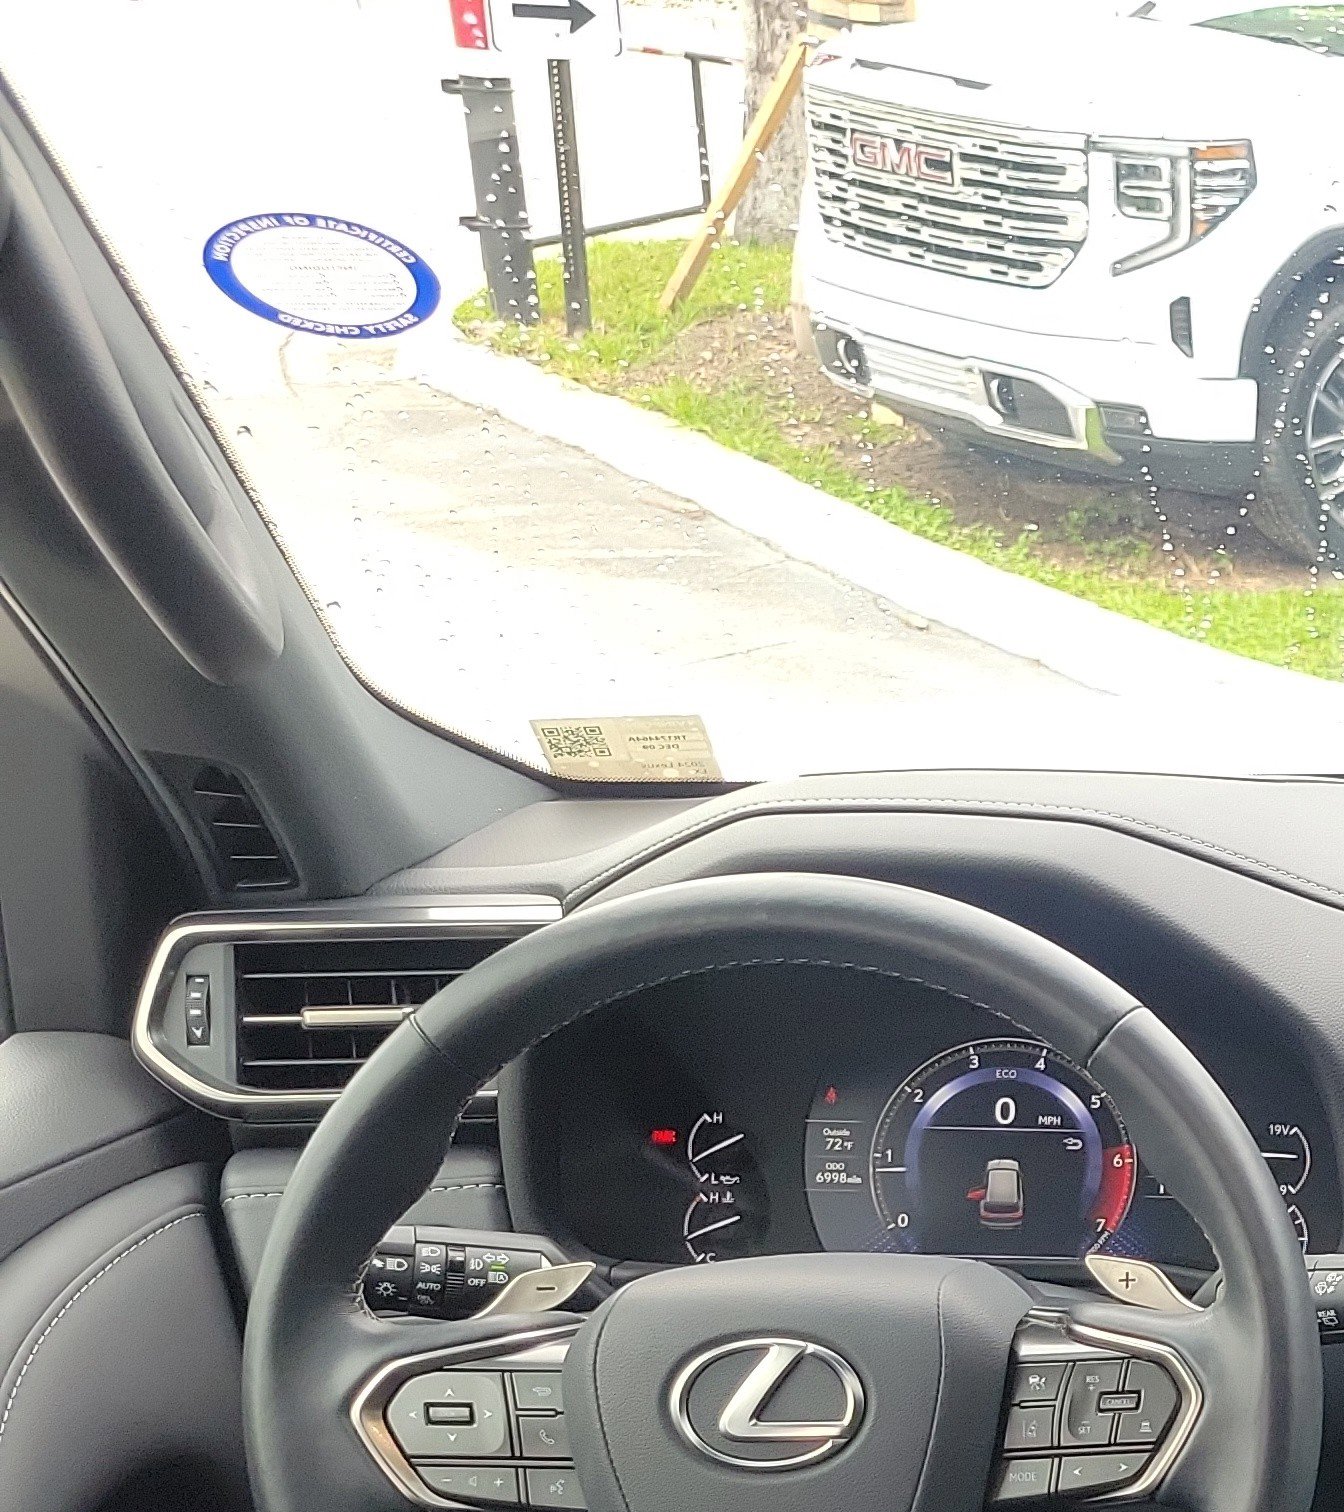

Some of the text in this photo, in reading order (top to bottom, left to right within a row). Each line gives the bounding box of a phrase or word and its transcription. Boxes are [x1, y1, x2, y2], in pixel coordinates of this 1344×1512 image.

[851, 131, 952, 186] GMC
[969, 1055, 980, 1069] 3
[1035, 1056, 1046, 1070] 4
[995, 1069, 1018, 1079] ECO
[914, 1089, 924, 1103] 2
[1090, 1095, 1101, 1109] 5
[994, 1097, 1016, 1125] 0
[713, 1111, 723, 1124] H
[1038, 1115, 1062, 1126] MPH
[1269, 1124, 1290, 1135] 19V
[885, 1149, 892, 1162] 1
[1113, 1154, 1123, 1168] 6
[825, 1162, 845, 1171] ODO
[711, 1172, 718, 1184] L
[816, 1172, 847, 1184] 6998
[1279, 1184, 1288, 1195] 9
[709, 1192, 719, 1203] H
[897, 1214, 909, 1228] 0
[1096, 1219, 1106, 1233] 7
[706, 1252, 716, 1264] C
[416, 1280, 441, 1291] AUTO
[467, 1277, 487, 1287] OFF
[1078, 1426, 1091, 1435] SET
[1009, 1473, 1038, 1482] MODE
